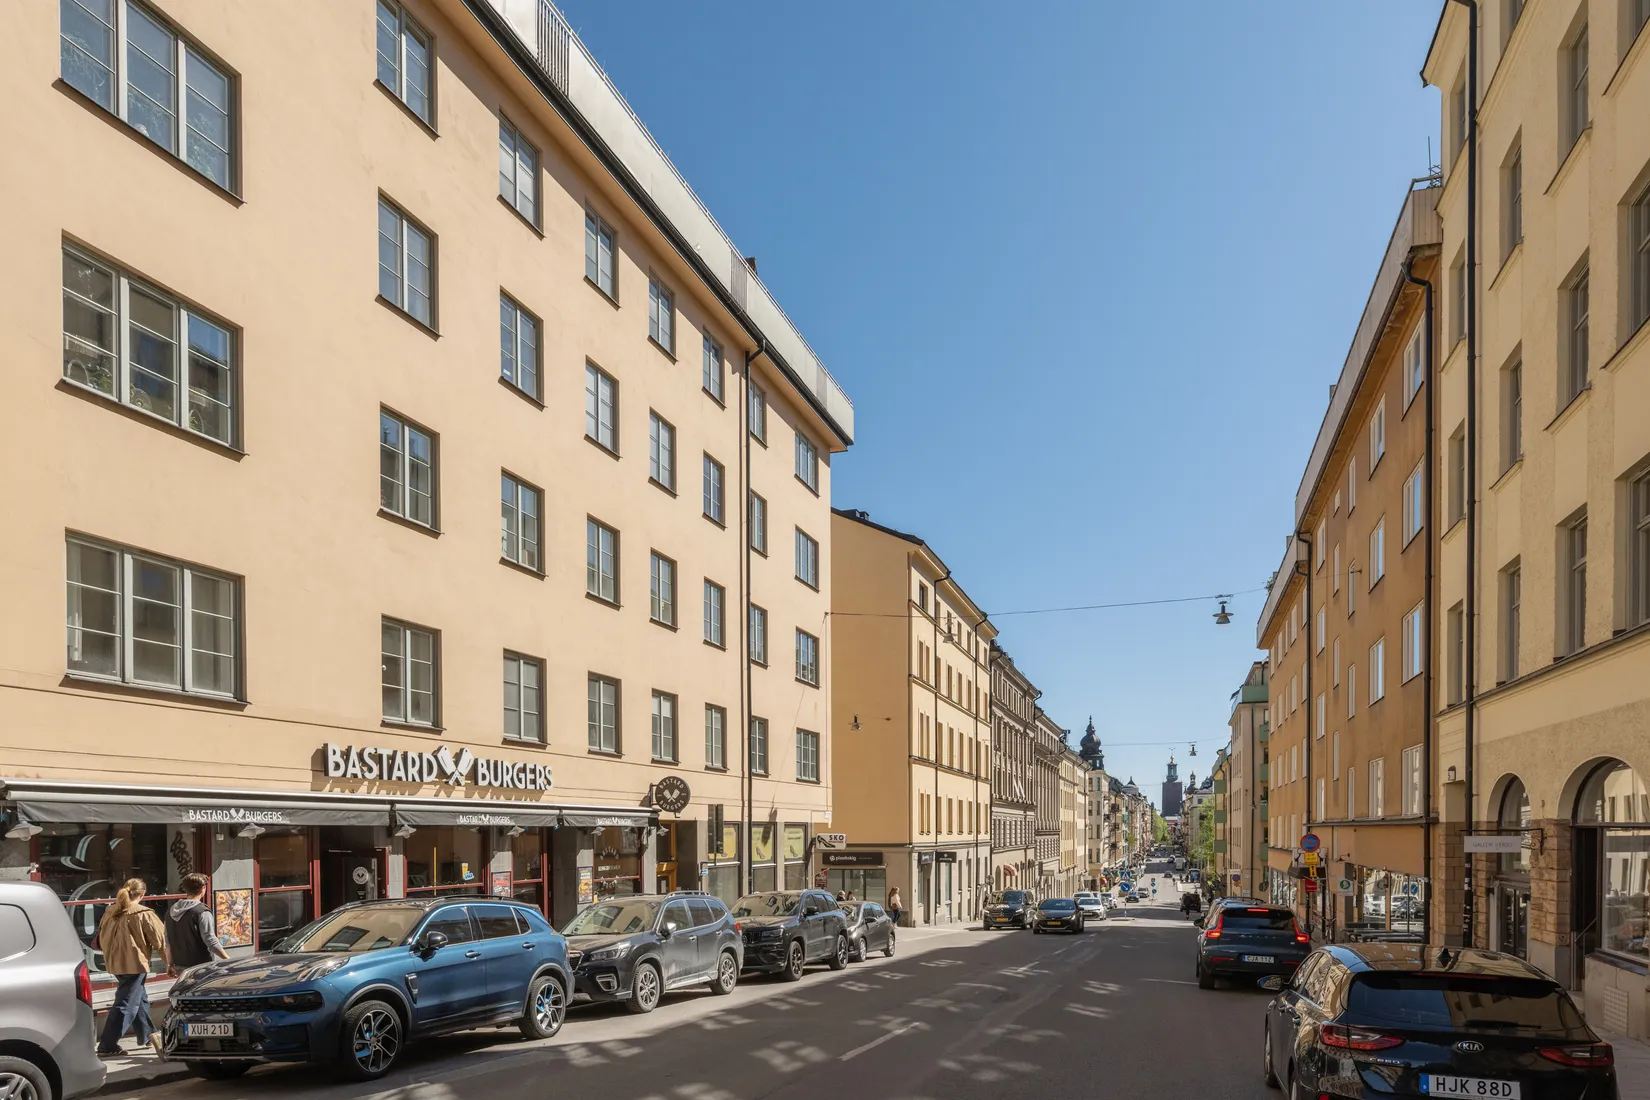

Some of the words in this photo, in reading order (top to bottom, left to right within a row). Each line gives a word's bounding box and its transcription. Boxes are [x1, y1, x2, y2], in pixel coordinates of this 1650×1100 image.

[324, 742, 438, 783] BASTARD
[474, 757, 554, 791] BURGERS
[659, 778, 685, 789] BASTARD
[659, 799, 685, 811] BURGERS
[188, 809, 230, 821] BASTARD
[245, 811, 283, 822] BURGERS
[459, 814, 483, 823] BASTARD
[190, 1024, 209, 1035] XUH
[210, 1024, 230, 1035] 21D
[1462, 1042, 1481, 1051] KIA
[1435, 1076, 1471, 1094] HJK
[1476, 1080, 1513, 1097] 88D
